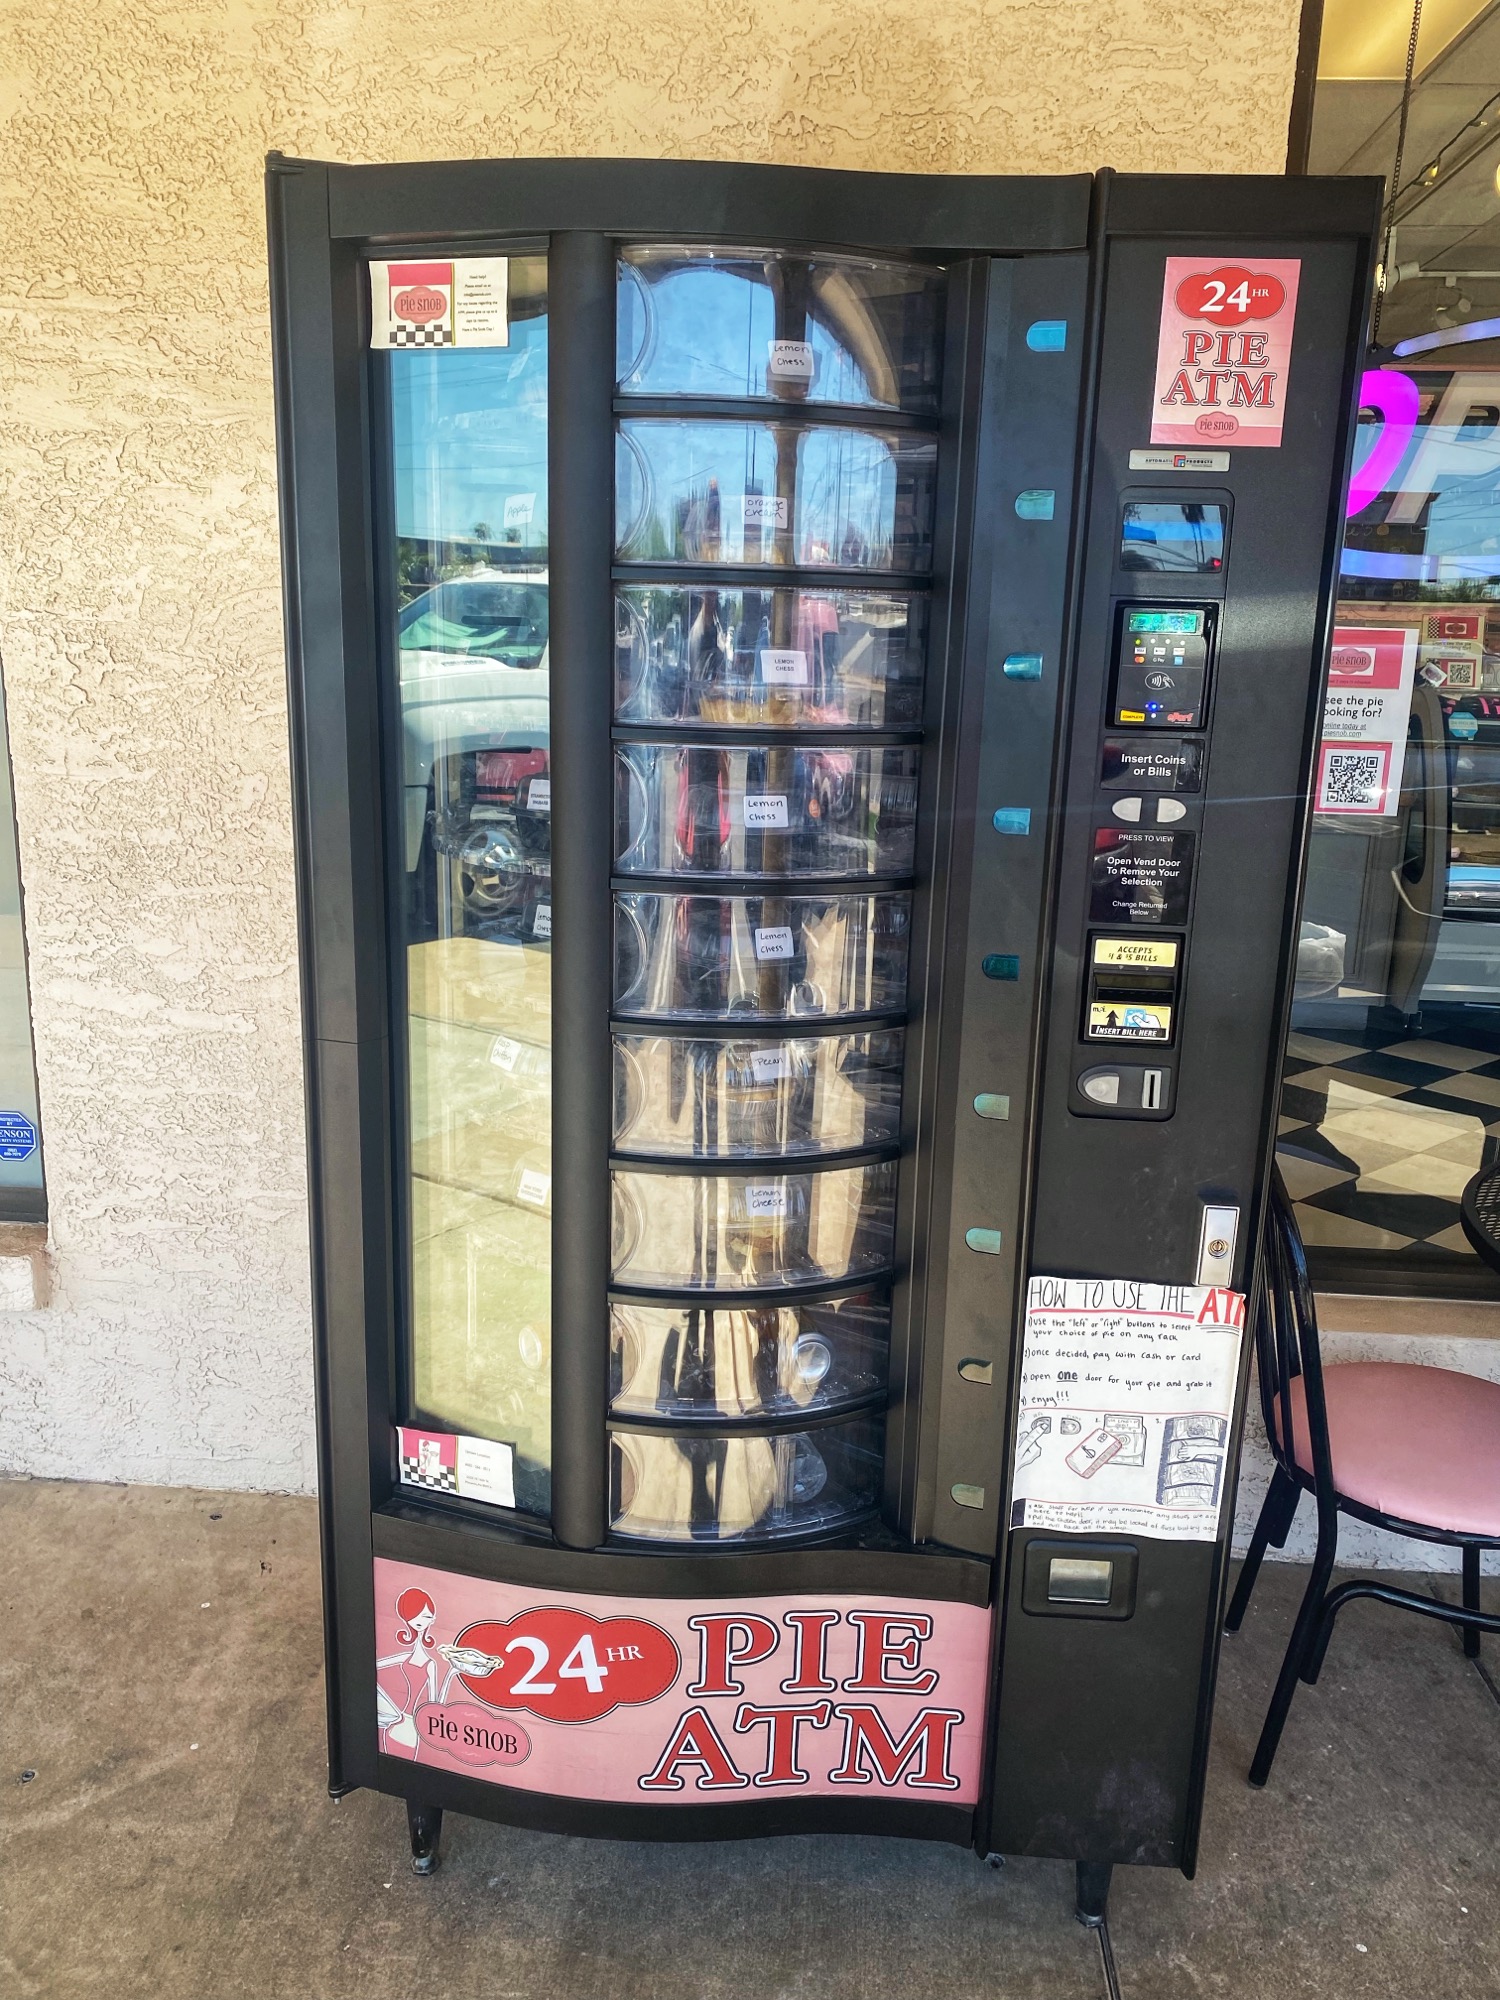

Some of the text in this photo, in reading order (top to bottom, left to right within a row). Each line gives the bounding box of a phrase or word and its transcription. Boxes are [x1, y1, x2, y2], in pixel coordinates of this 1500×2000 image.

[1199, 281, 1269, 312] 24 HR
[400, 295, 415, 311] Pie
[1180, 330, 1270, 367] PIE
[1161, 369, 1277, 408] ATM
[1200, 419, 1212, 430] Pie
[1325, 696, 1384, 708] see the pie
[1323, 707, 1383, 719] ooking for?
[1121, 753, 1186, 764] Insert Coins
[1133, 767, 1171, 776] or Bills
[1118, 834, 1142, 842] PRESS
[1107, 857, 1181, 867] Open Vend Door
[1107, 867, 1180, 877] To Remove Your
[1121, 877, 1163, 886] Selection
[1112, 901, 1168, 909] Change Returned
[537, 911, 551, 921] Lemo
[760, 932, 787, 940] Lemon
[1117, 946, 1153, 954] ACCEPTS
[1126, 953, 1133, 961] $5
[1135, 954, 1158, 962] BILLS
[1095, 1026, 1158, 1037] INSERT BILL HERE
[756, 1057, 783, 1066] Pecan
[1029, 1279, 1067, 1309] HOW
[1076, 1281, 1104, 1309] TO
[1112, 1282, 1149, 1310] USE
[1160, 1285, 1194, 1313] THE
[1052, 1319, 1065, 1327] the
[1126, 1318, 1155, 1328] buttons
[1159, 1321, 1168, 1329] to
[1171, 1323, 1191, 1331] select
[1033, 1329, 1052, 1339] your
[1059, 1329, 1086, 1337] choice
[1102, 1330, 1115, 1339] pie
[1137, 1333, 1155, 1343] any
[1158, 1333, 1178, 1341] rack
[1055, 1349, 1090, 1359] decided,
[1092, 1352, 1111, 1362] pay
[1115, 1351, 1136, 1359] with
[1030, 1373, 1051, 1382] open
[1057, 1370, 1079, 1380] one
[1084, 1373, 1102, 1382] door
[1108, 1375, 1120, 1384] for
[1125, 1379, 1143, 1391] your
[1147, 1381, 1161, 1391] pie
[1185, 1381, 1204, 1392] grab
[686, 1609, 940, 1698] PIE
[505, 1634, 645, 1695] 24 HR
[427, 1713, 458, 1741] Pie
[637, 1699, 965, 1791] ATM
